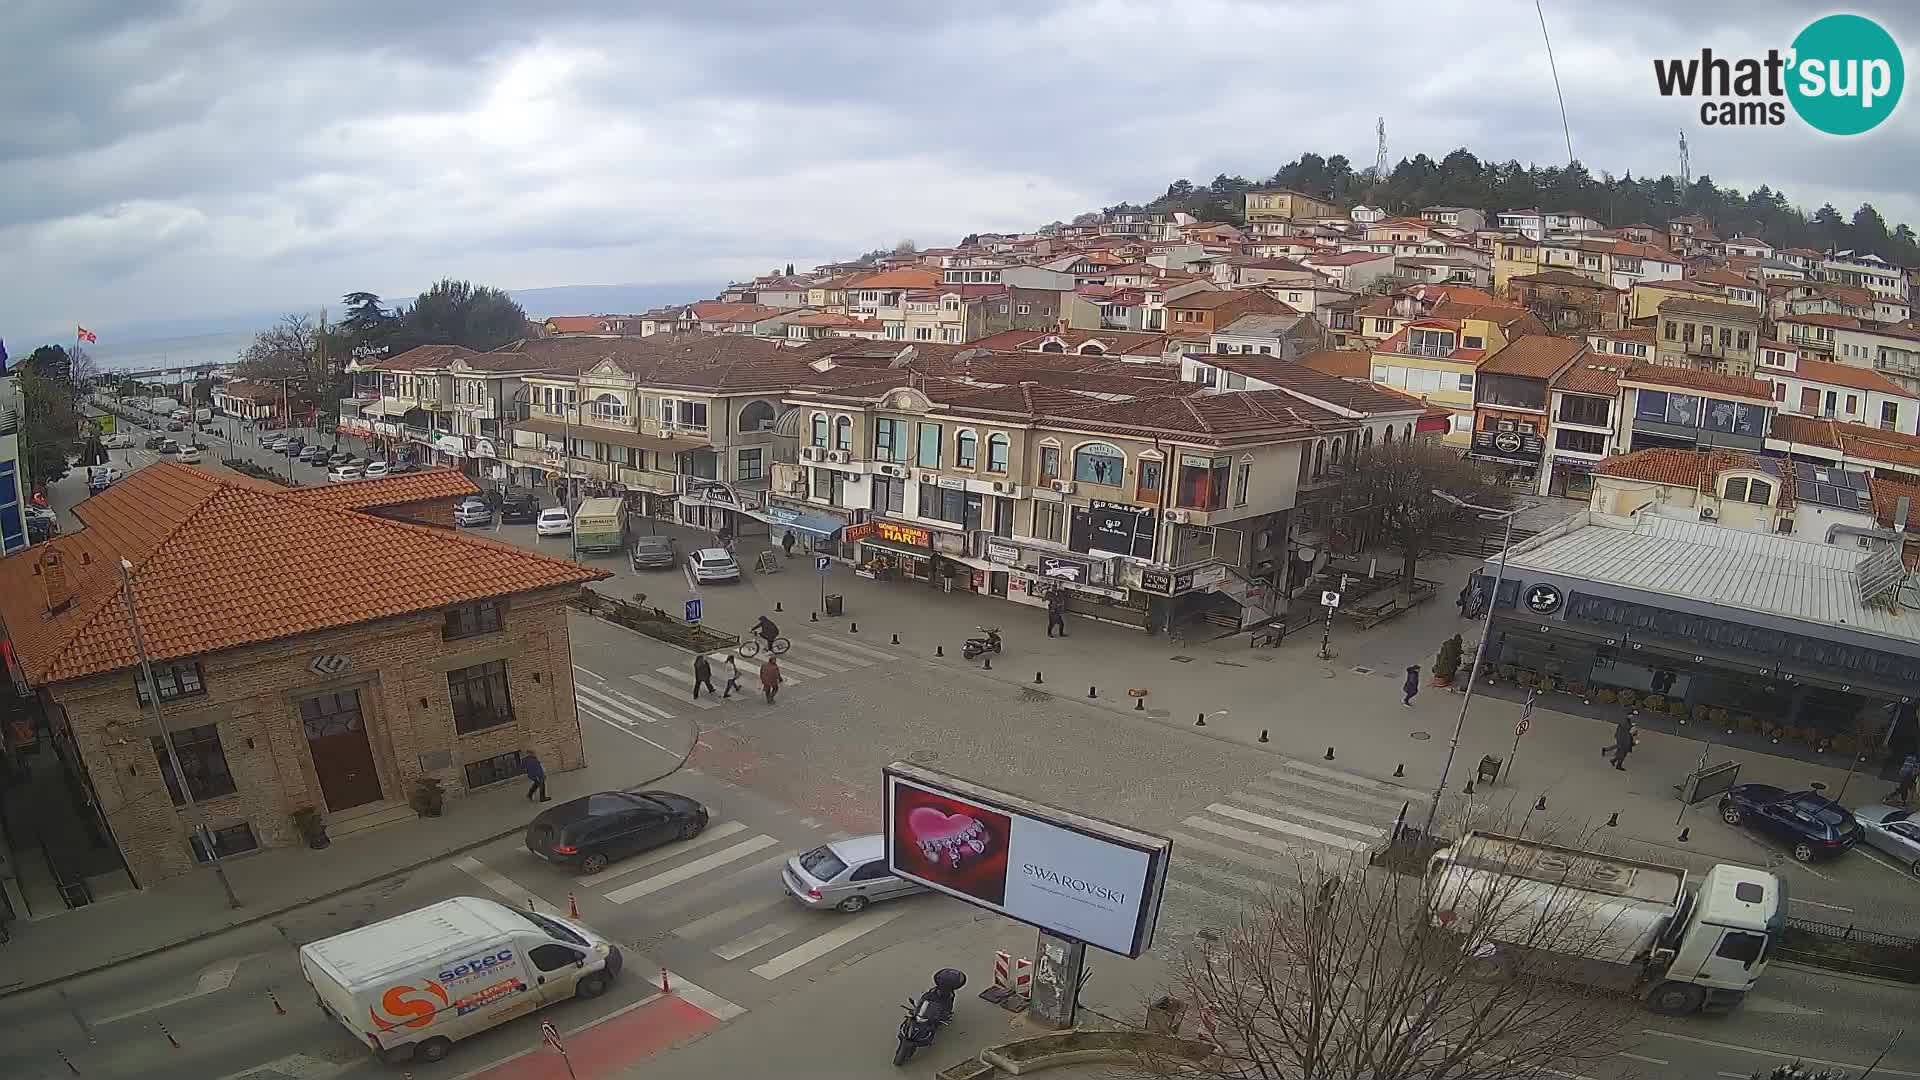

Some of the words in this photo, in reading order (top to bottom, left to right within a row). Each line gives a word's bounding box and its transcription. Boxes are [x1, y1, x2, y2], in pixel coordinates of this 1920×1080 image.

[819, 558, 828, 570] P
[1023, 863, 1125, 905] SWAROVSKI
[439, 950, 513, 982] setec
